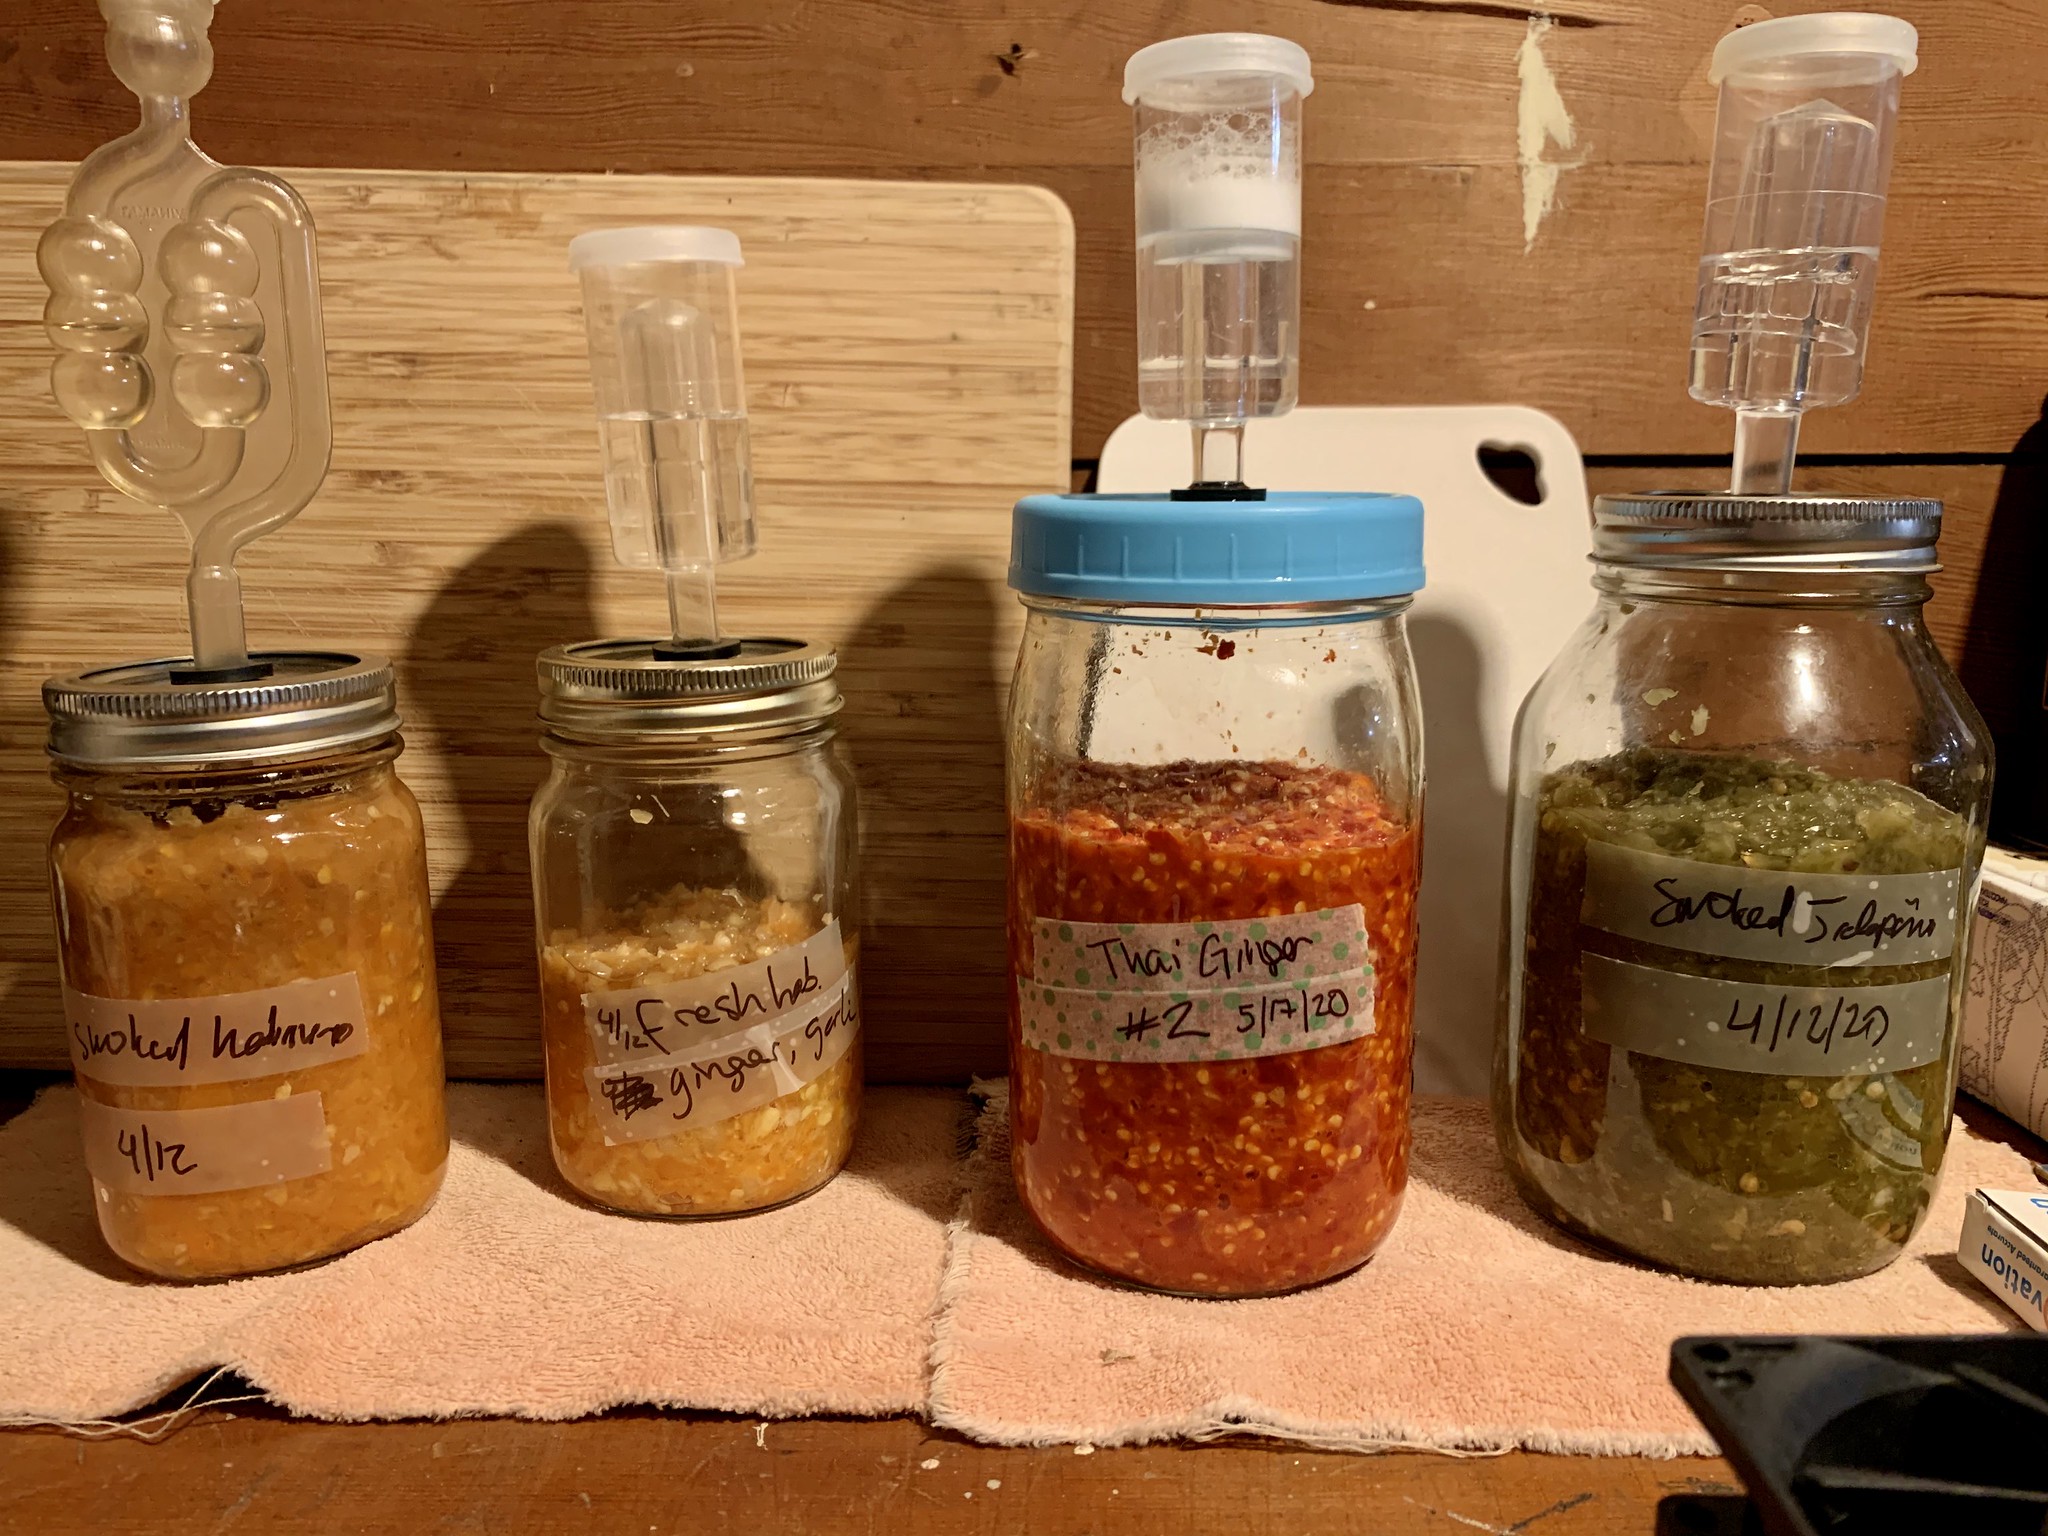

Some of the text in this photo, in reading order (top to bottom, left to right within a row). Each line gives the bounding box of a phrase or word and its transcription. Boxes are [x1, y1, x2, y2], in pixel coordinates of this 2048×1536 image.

[1650, 878, 1795, 938] Smoked
[1086, 933, 1313, 980] Thai Ginger
[1116, 988, 1350, 1042] #2 5/17/20
[1726, 994, 1890, 1054] 4/12/20
[117, 1124, 198, 1181] 4/12
